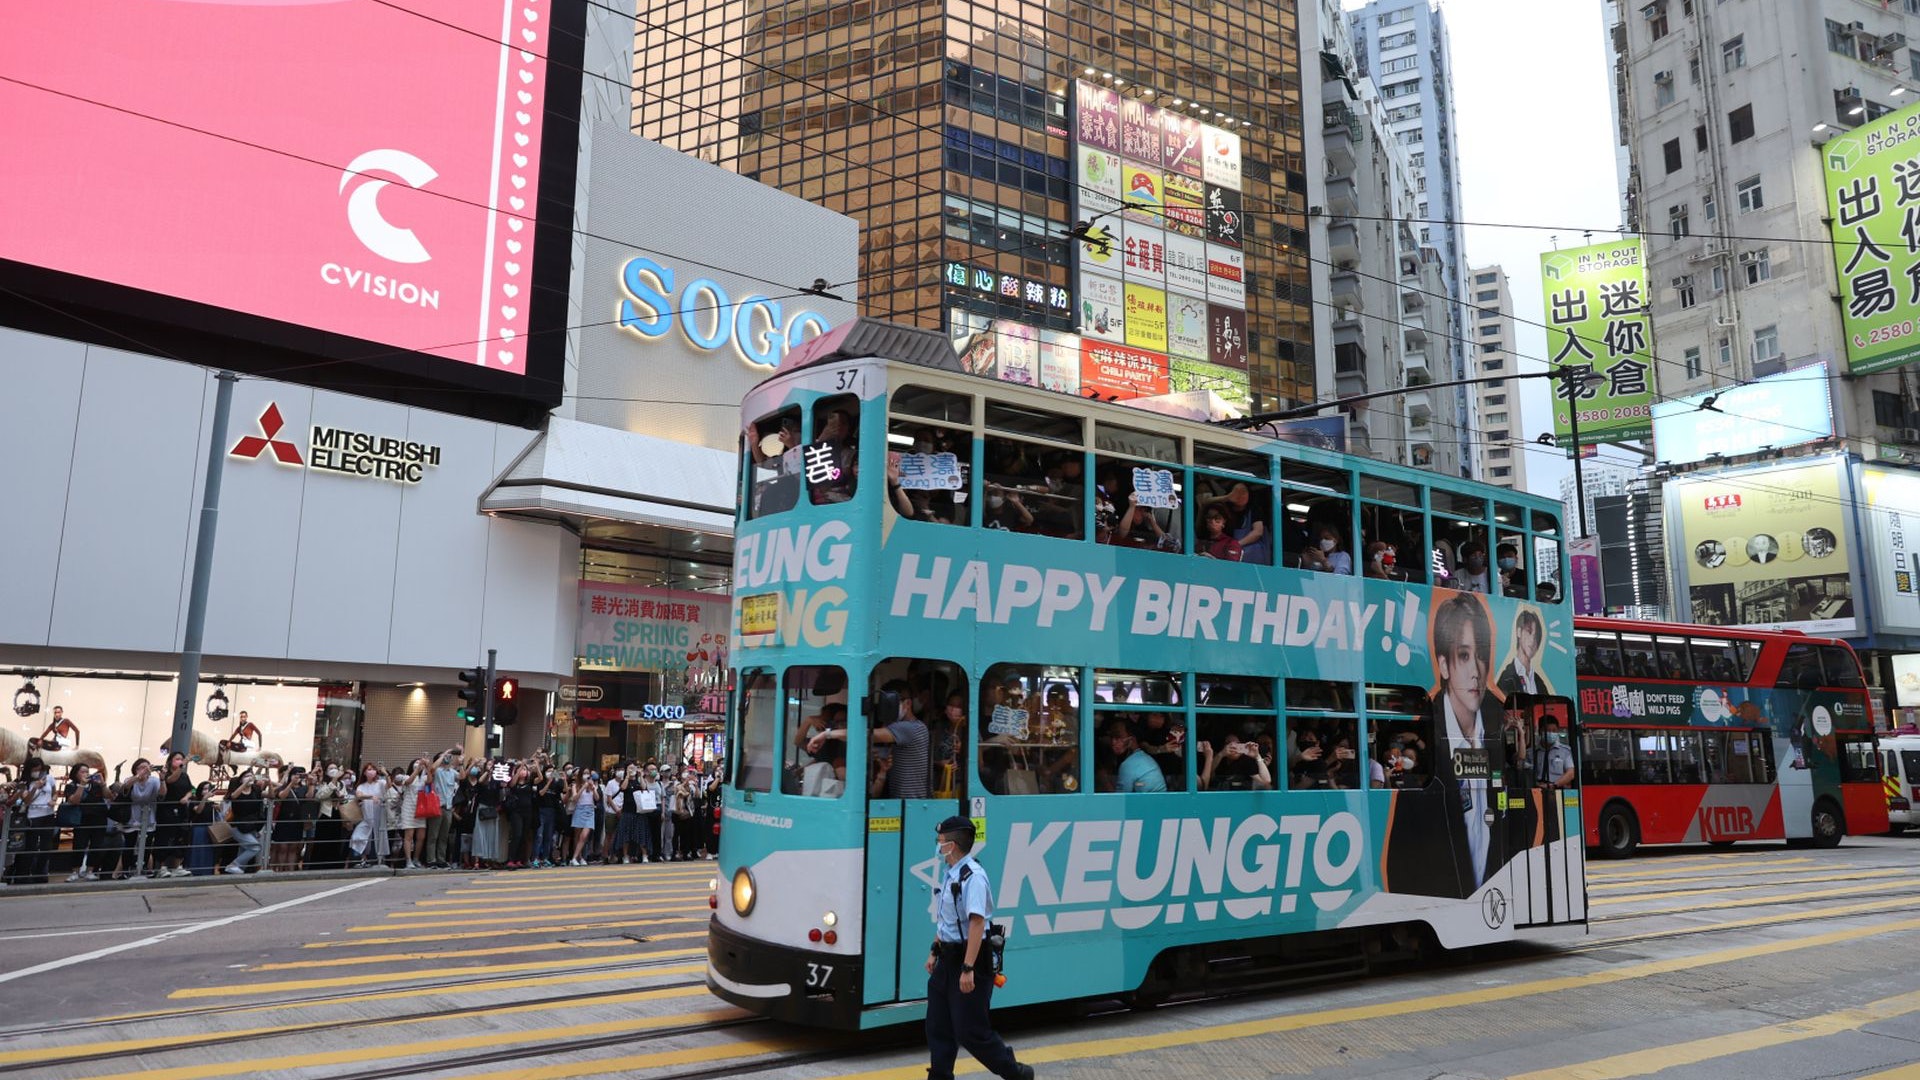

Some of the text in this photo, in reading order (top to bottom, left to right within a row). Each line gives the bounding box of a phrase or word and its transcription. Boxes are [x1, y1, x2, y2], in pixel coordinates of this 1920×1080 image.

[1867, 130, 1881, 144] IN
[1888, 123, 1898, 135] N
[1867, 126, 1920, 155] STORA
[1578, 247, 1638, 263] IN N OUT
[1839, 177, 1896, 318] 出入易
[1578, 257, 1638, 273] STORAGE
[320, 262, 440, 310] CVISION
[1600, 279, 1648, 397] 迷你倉
[1870, 321, 1912, 343] 2580
[836, 369, 858, 390] 37
[1101, 365, 1152, 382] CHILI PARTY
[1614, 404, 1650, 419] 2088
[313, 426, 441, 466] MITSUBISHI
[310, 447, 423, 483] ELECTRIC
[890, 553, 1126, 631] HAPPY
[592, 595, 700, 623] 崇光消費加碼賞
[613, 621, 689, 647] SPRING
[586, 644, 688, 671] REWARDS
[643, 704, 685, 719] SOGO
[1646, 694, 1685, 704] DON'T FEED
[1647, 705, 1681, 715] WILD PIGS
[1454, 752, 1463, 776] 8
[1699, 806, 1755, 841] KMB
[806, 963, 834, 988] 37
